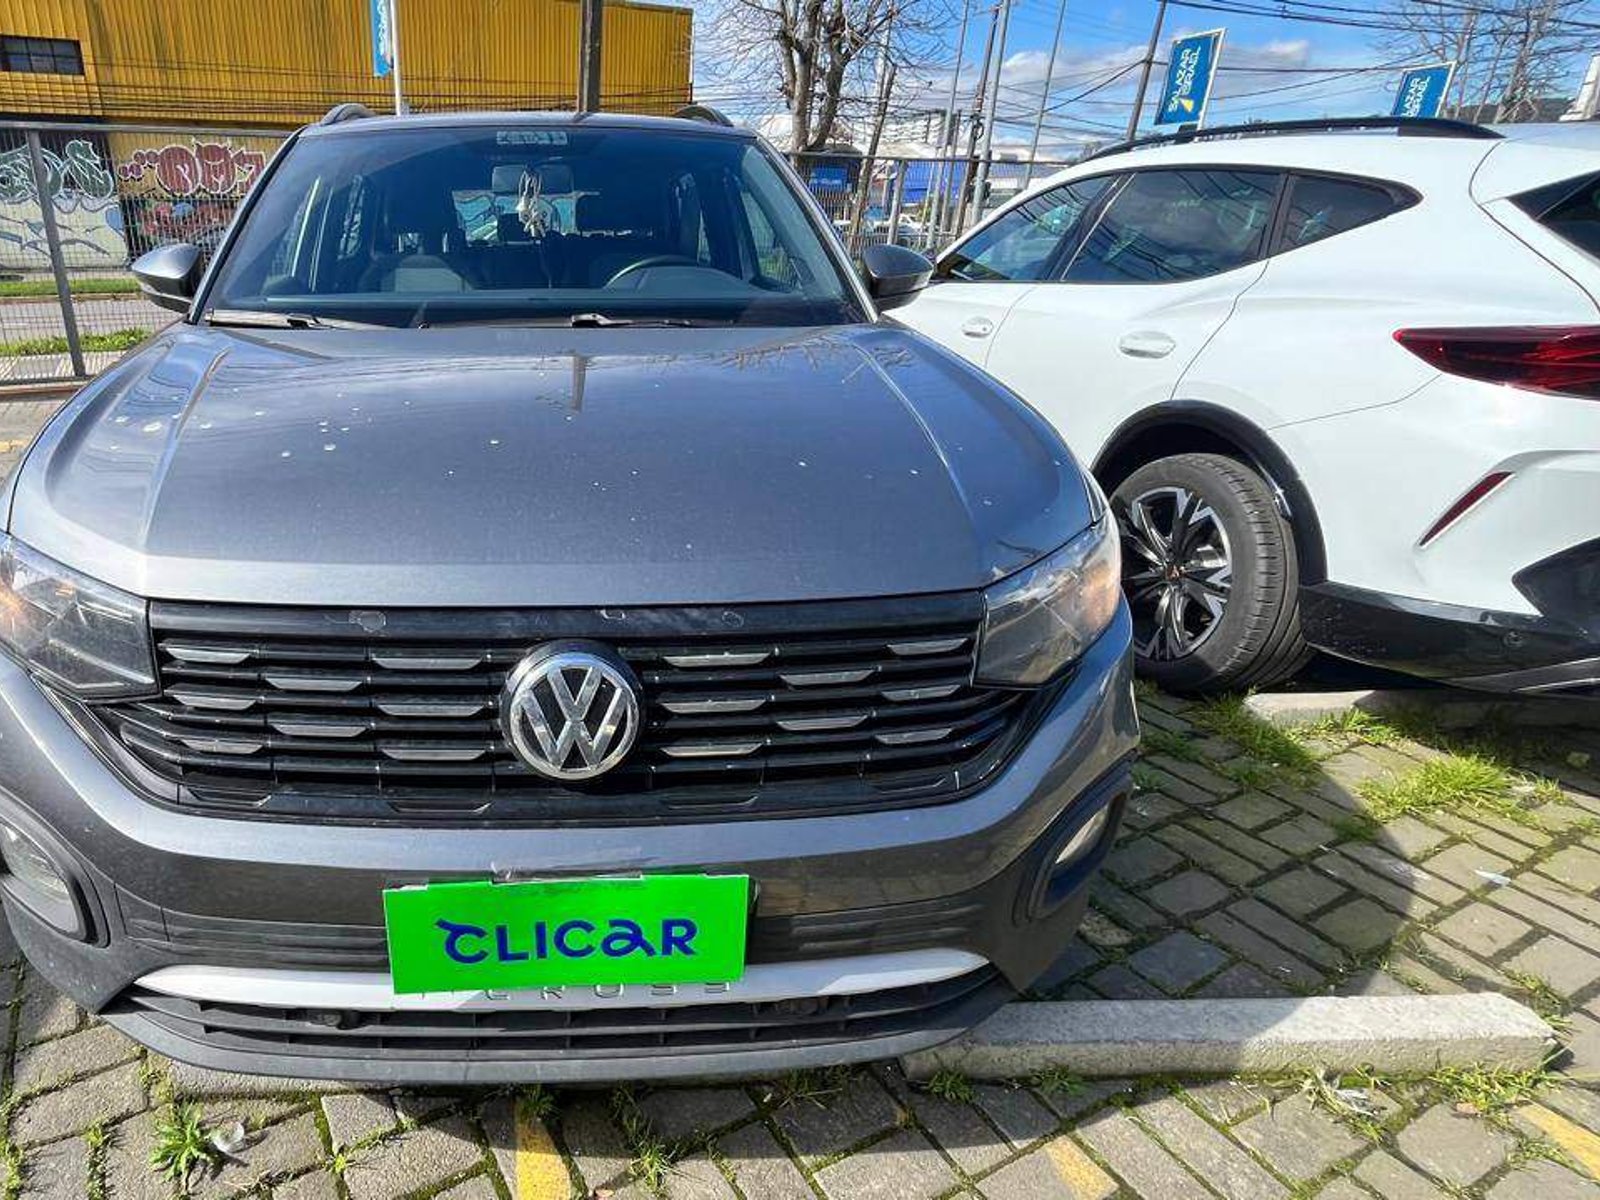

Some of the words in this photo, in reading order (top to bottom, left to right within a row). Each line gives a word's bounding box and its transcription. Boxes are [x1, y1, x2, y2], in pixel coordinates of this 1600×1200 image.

[1168, 48, 1192, 112] SALAZAR
[1401, 78, 1421, 117] LAZAR
[421, 981, 730, 1001] CROSS
